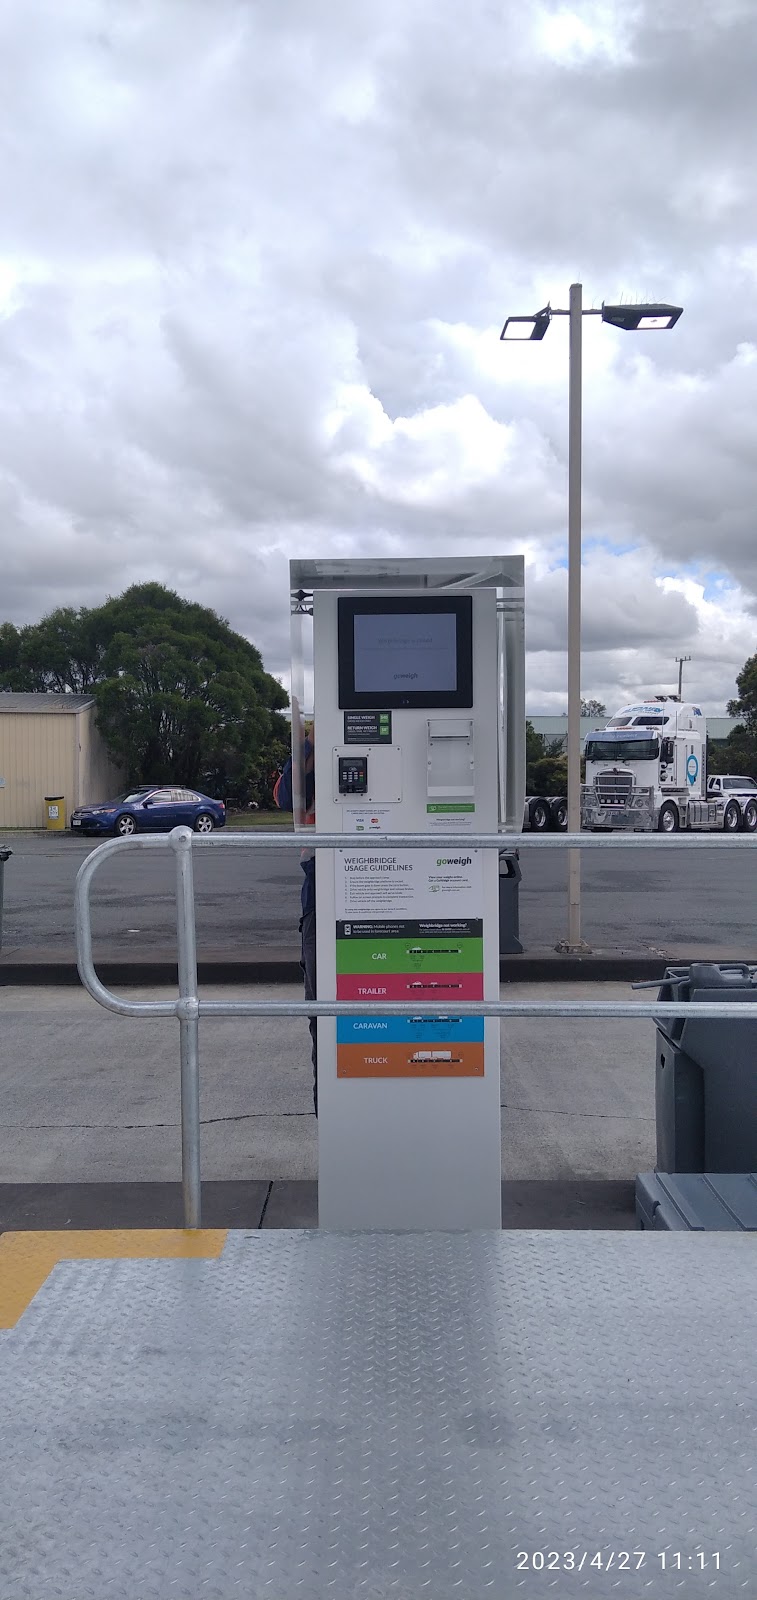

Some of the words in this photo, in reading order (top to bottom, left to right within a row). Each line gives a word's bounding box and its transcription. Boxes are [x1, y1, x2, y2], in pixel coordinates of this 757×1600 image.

[436, 856, 472, 867] goweigh
[344, 864, 368, 872] USAGE
[369, 864, 413, 872] GUIDELINES
[358, 987, 387, 995] TRAILER
[353, 1022, 388, 1030] CARAVAN
